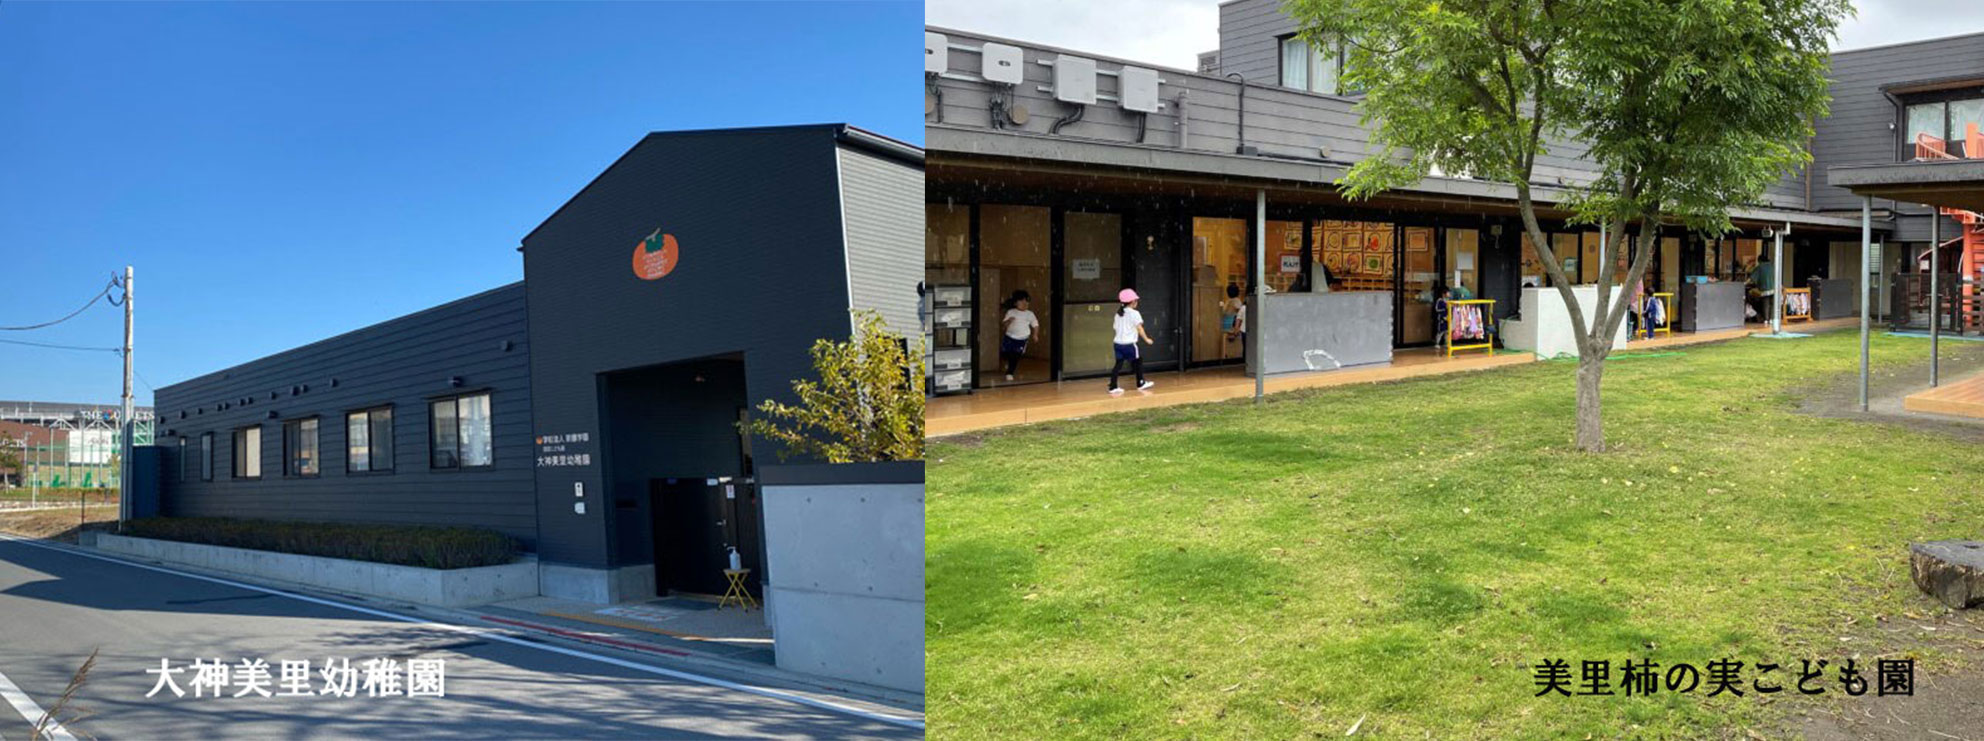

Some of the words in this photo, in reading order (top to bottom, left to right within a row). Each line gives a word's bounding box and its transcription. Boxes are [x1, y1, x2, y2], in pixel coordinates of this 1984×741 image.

[537, 453, 591, 467] 大神美里幼稚園
